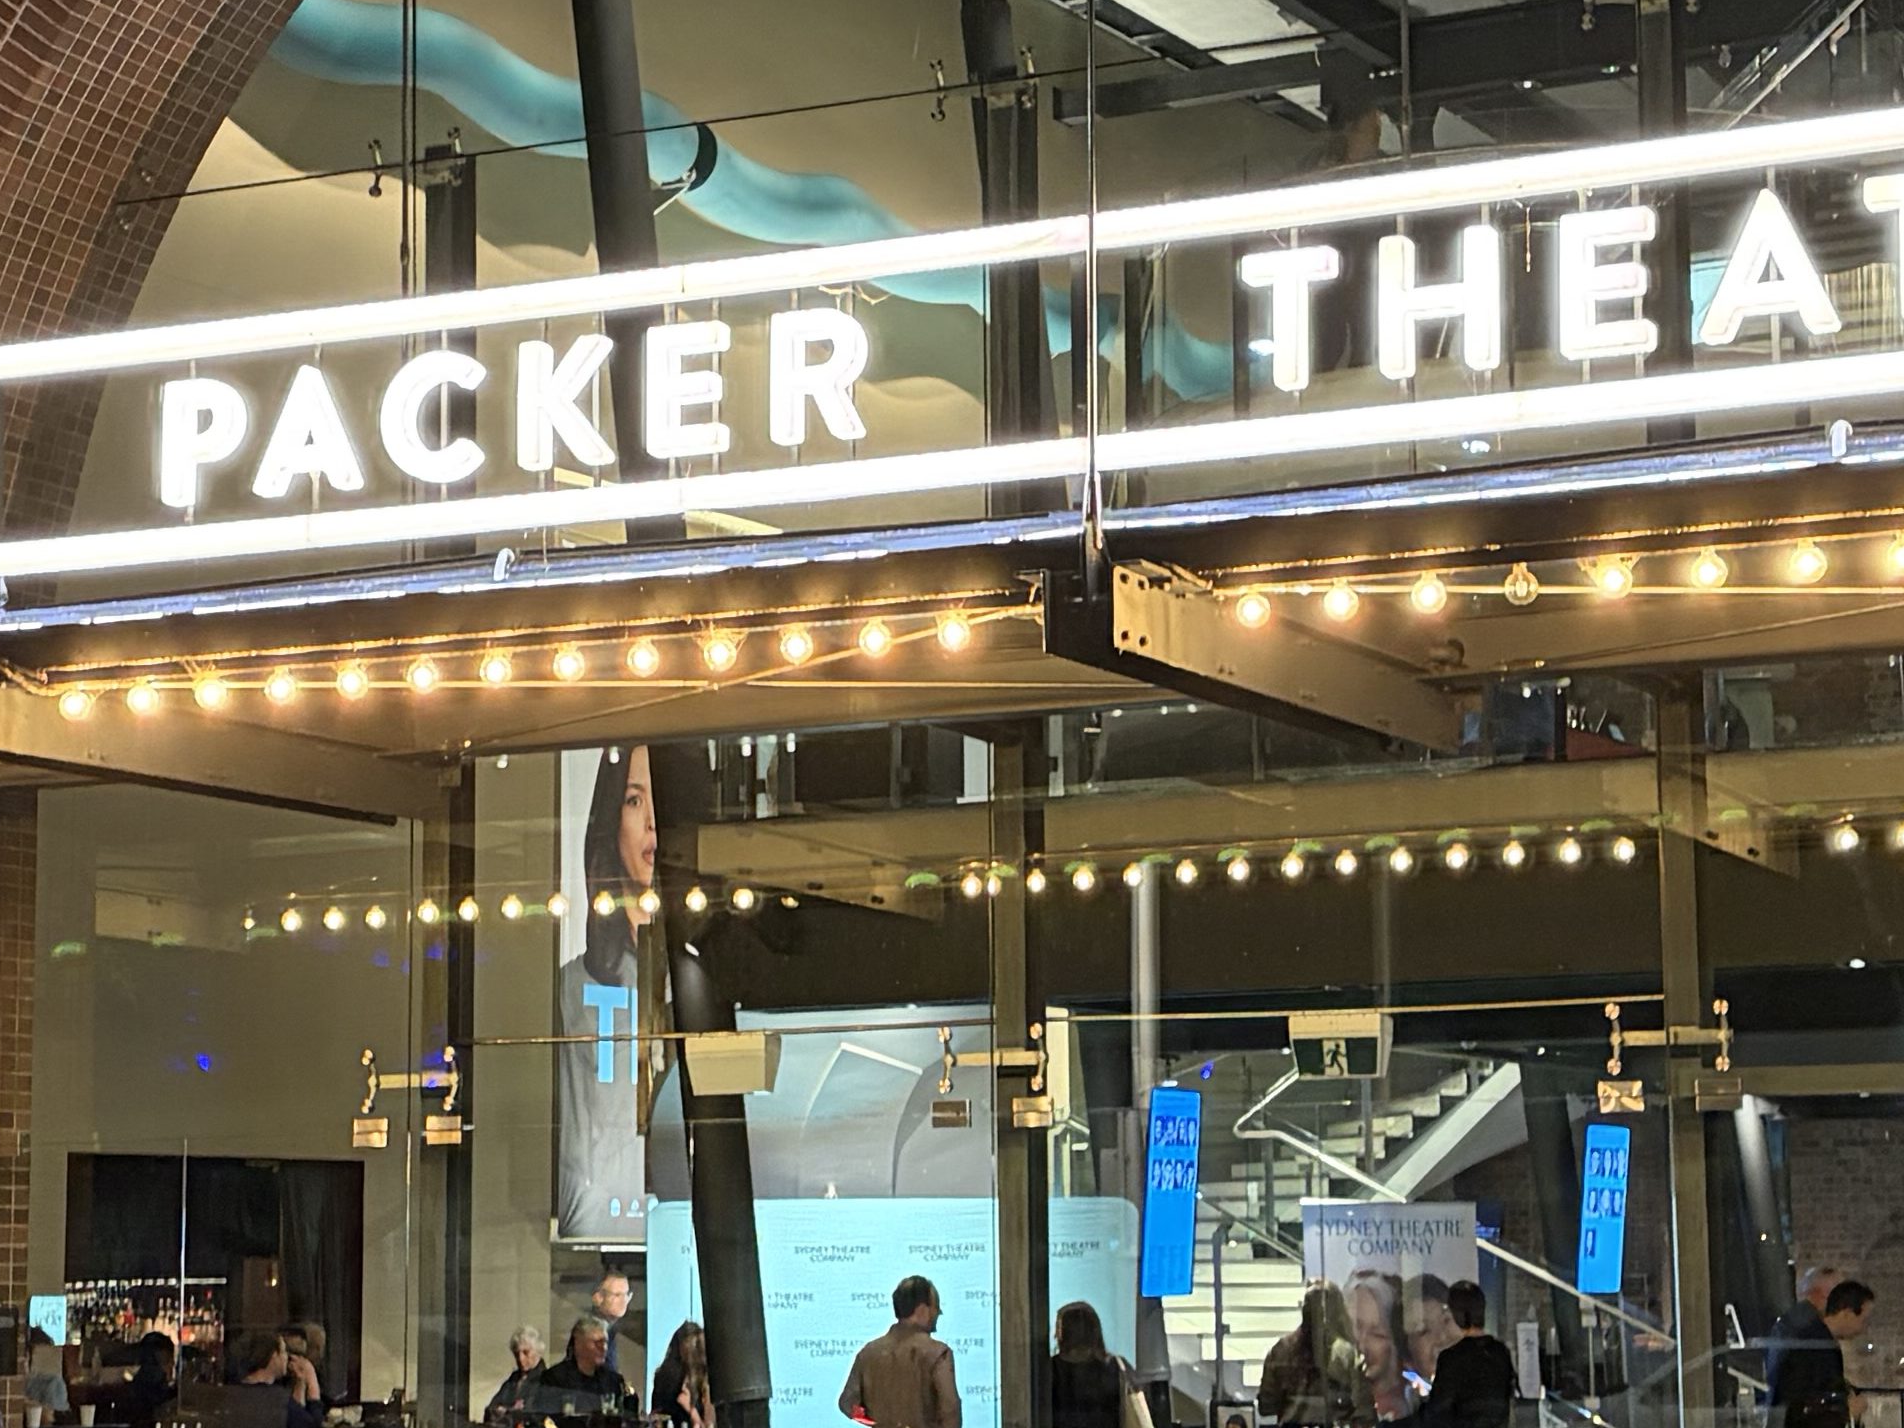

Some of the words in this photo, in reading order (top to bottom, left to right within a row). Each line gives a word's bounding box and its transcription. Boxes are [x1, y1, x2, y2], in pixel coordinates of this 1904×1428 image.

[158, 307, 871, 509] PACKER
[1315, 1218, 1383, 1238] SYDNEY
[1388, 1218, 1464, 1238] THEATRE
[1347, 1238, 1435, 1256] COMPANY
